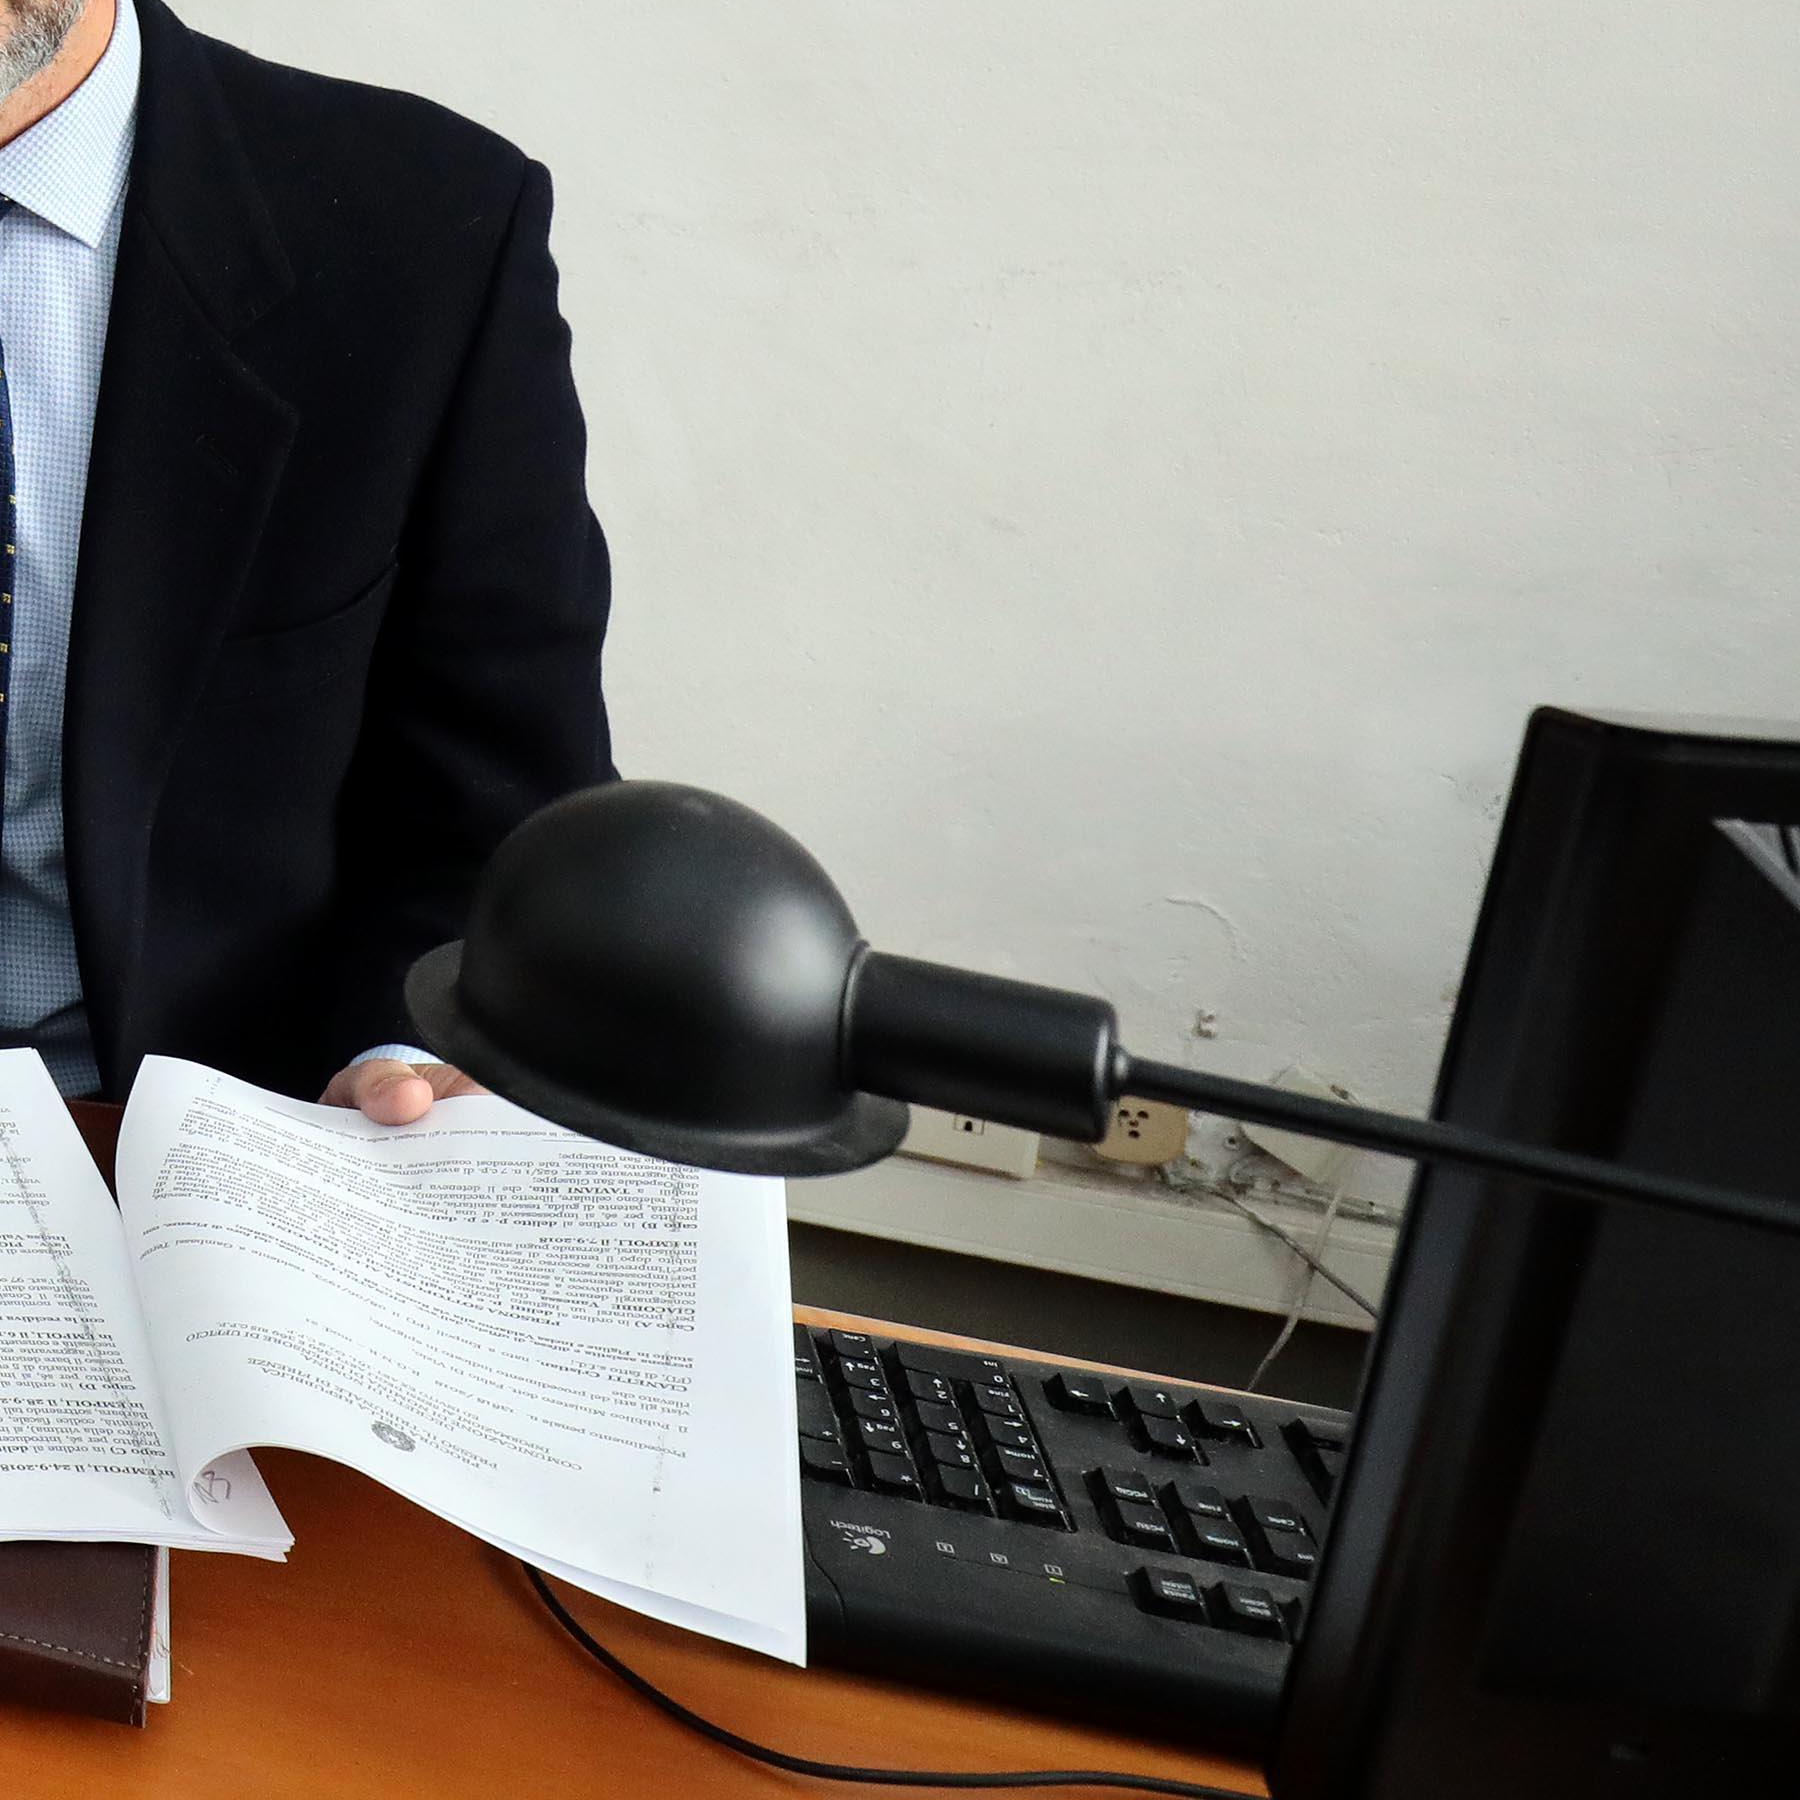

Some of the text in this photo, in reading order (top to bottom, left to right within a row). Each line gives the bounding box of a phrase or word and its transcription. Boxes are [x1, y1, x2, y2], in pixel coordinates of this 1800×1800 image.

[936, 1390, 948, 1399] 2
[1017, 1436, 1028, 1444] 4
[49, 1445, 89, 1454] ordine
[131, 1447, 166, 1458] capo
[961, 1454, 970, 1463] 8
[0, 1463, 71, 1472] 24.9.2018
[1032, 1468, 1043, 1478] 7
[830, 1519, 892, 1539] Logitech
